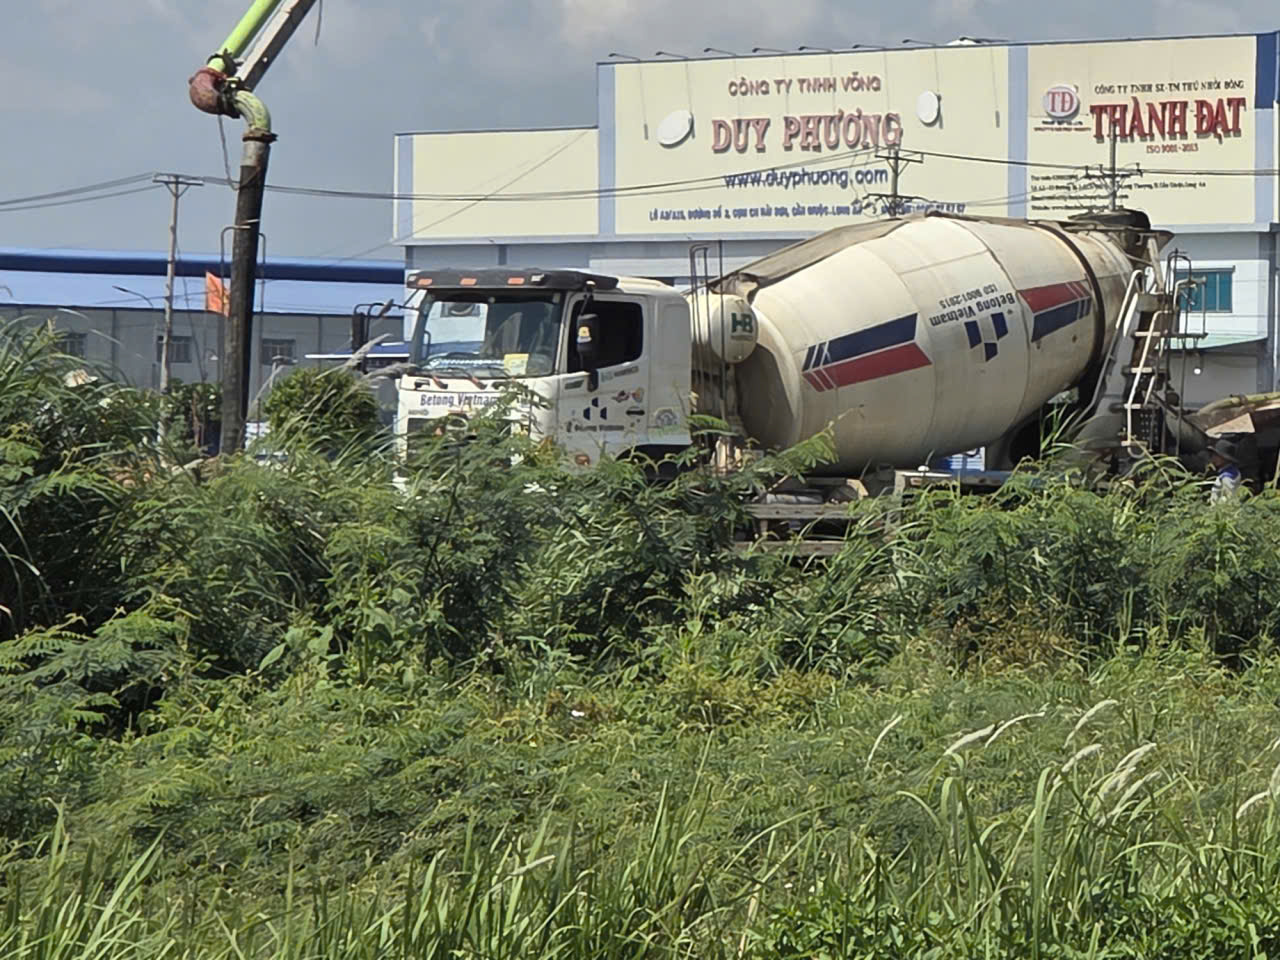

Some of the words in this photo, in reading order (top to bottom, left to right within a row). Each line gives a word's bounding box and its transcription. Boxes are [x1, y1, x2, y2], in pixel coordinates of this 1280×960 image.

[729, 77, 769, 96] CÔNG
[774, 79, 793, 94] TY
[798, 77, 837, 93] TNHH
[711, 118, 771, 154] DUY
[783, 107, 903, 153] PHƯƠNG
[1090, 96, 1188, 144] THÀNH
[1194, 97, 1246, 144] ĐẠT
[724, 168, 889, 190] www.duyphuong.com
[420, 394, 455, 408] Betong
